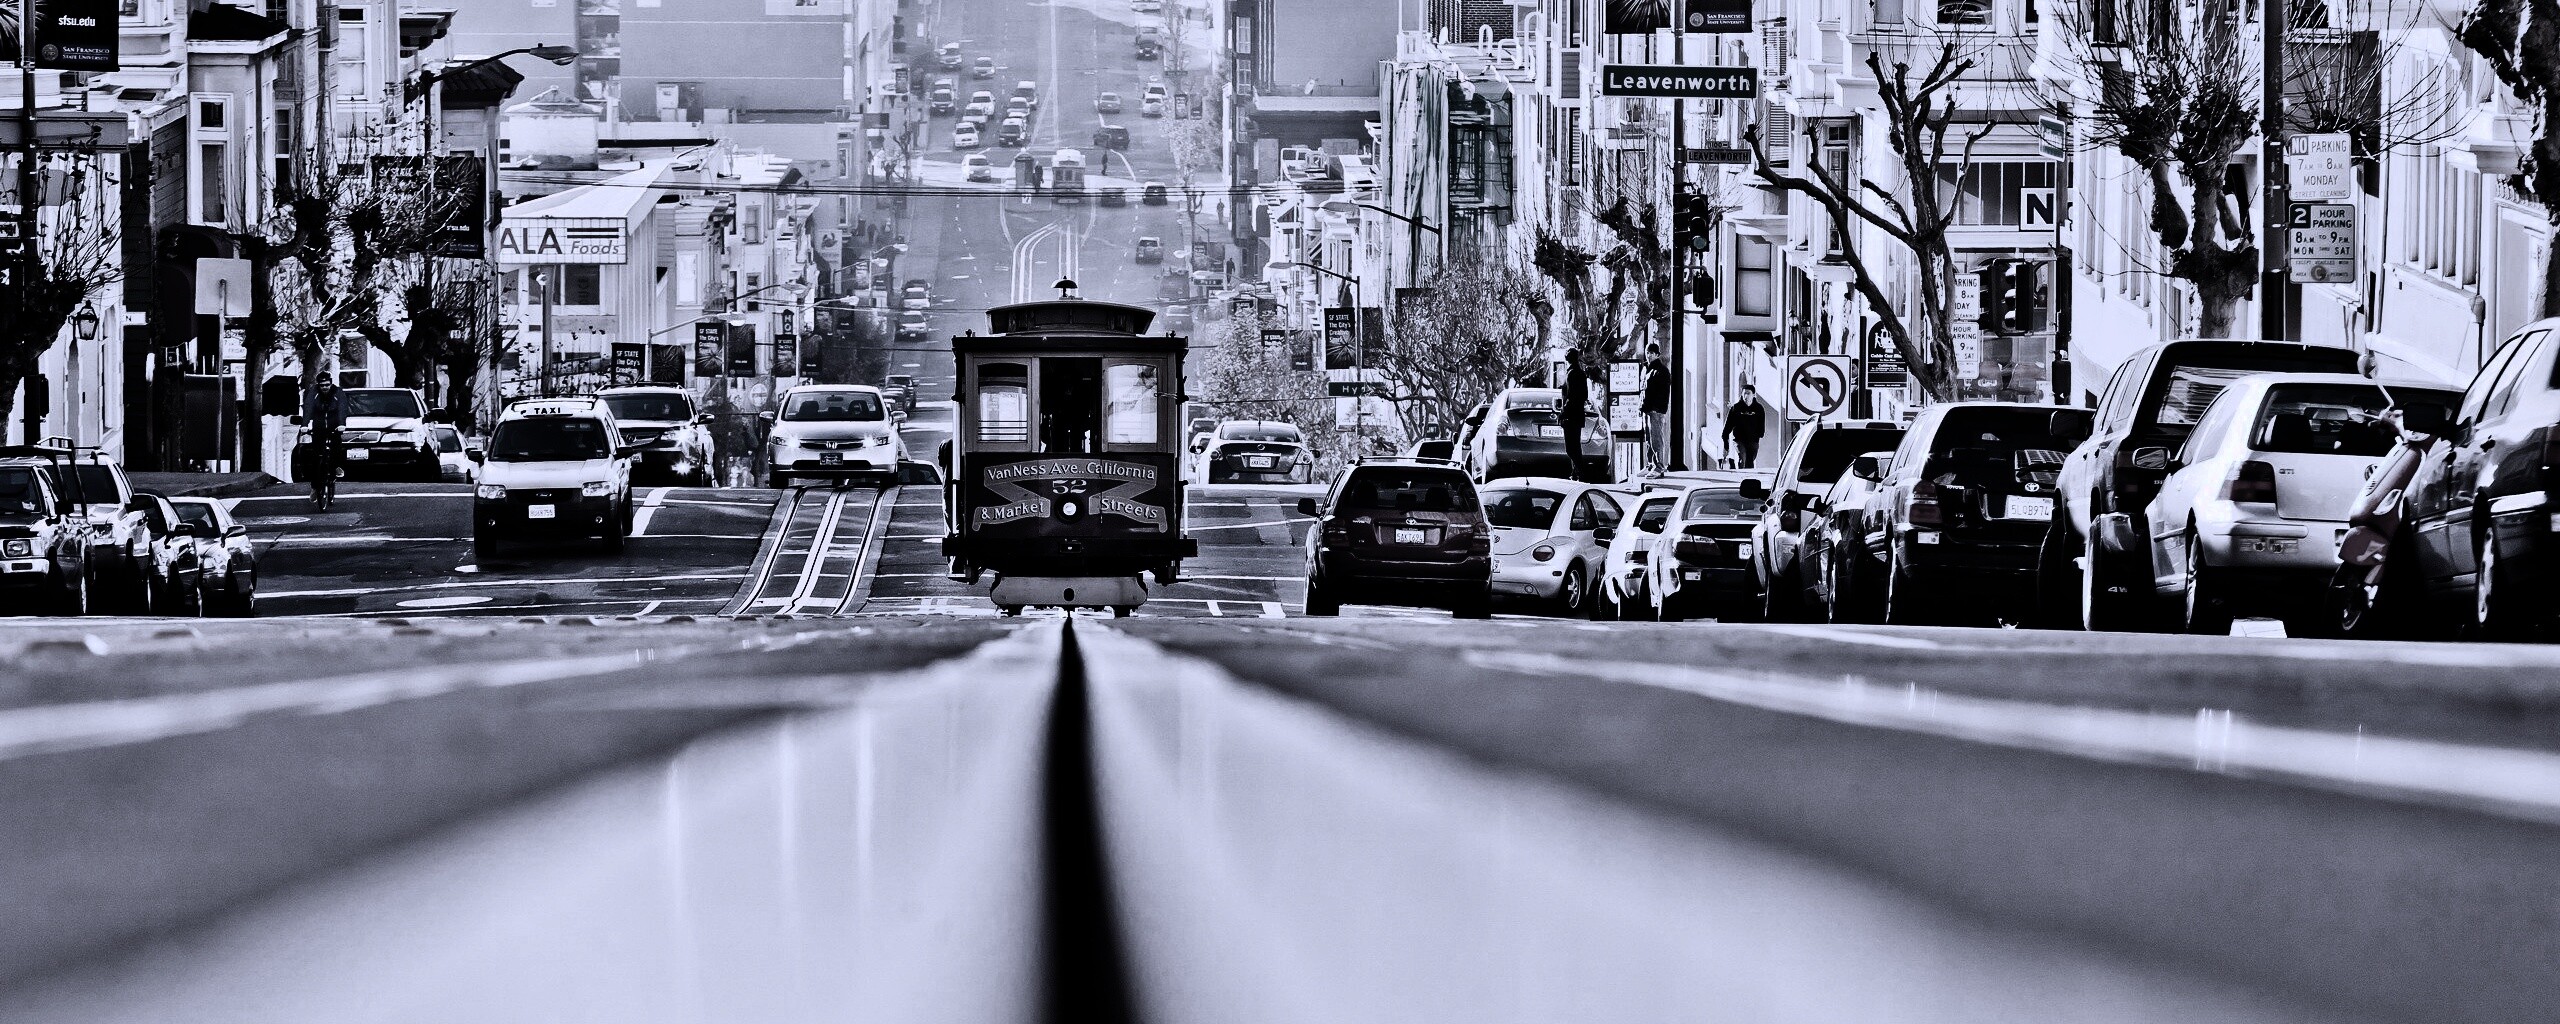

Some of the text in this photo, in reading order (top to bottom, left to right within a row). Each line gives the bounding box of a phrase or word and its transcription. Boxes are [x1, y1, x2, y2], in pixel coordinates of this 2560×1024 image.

[58, 15, 96, 27] sfsu.edu
[1609, 72, 1750, 91] Leavenworth
[2291, 137, 2347, 154] NO PARKING
[1688, 151, 1749, 161] LEAVENWORTH
[2303, 174, 2339, 186] MONDAY
[2294, 207, 2307, 224] 2
[2319, 209, 2346, 218] HOUR
[2312, 219, 2353, 229] PARKING
[570, 239, 620, 255] Foods
[2293, 247, 2315, 255] MON
[2334, 246, 2351, 256] SAT
[222, 365, 230, 374] 2
[1611, 397, 1618, 406] 2
[533, 407, 561, 415] TAXI
[987, 468, 1011, 480] Van
[1012, 464, 1046, 478] Ness
[1086, 461, 1155, 480] California
[1052, 479, 1087, 494] 52
[981, 501, 1044, 520] & Market
[1101, 498, 1158, 518] Streets
